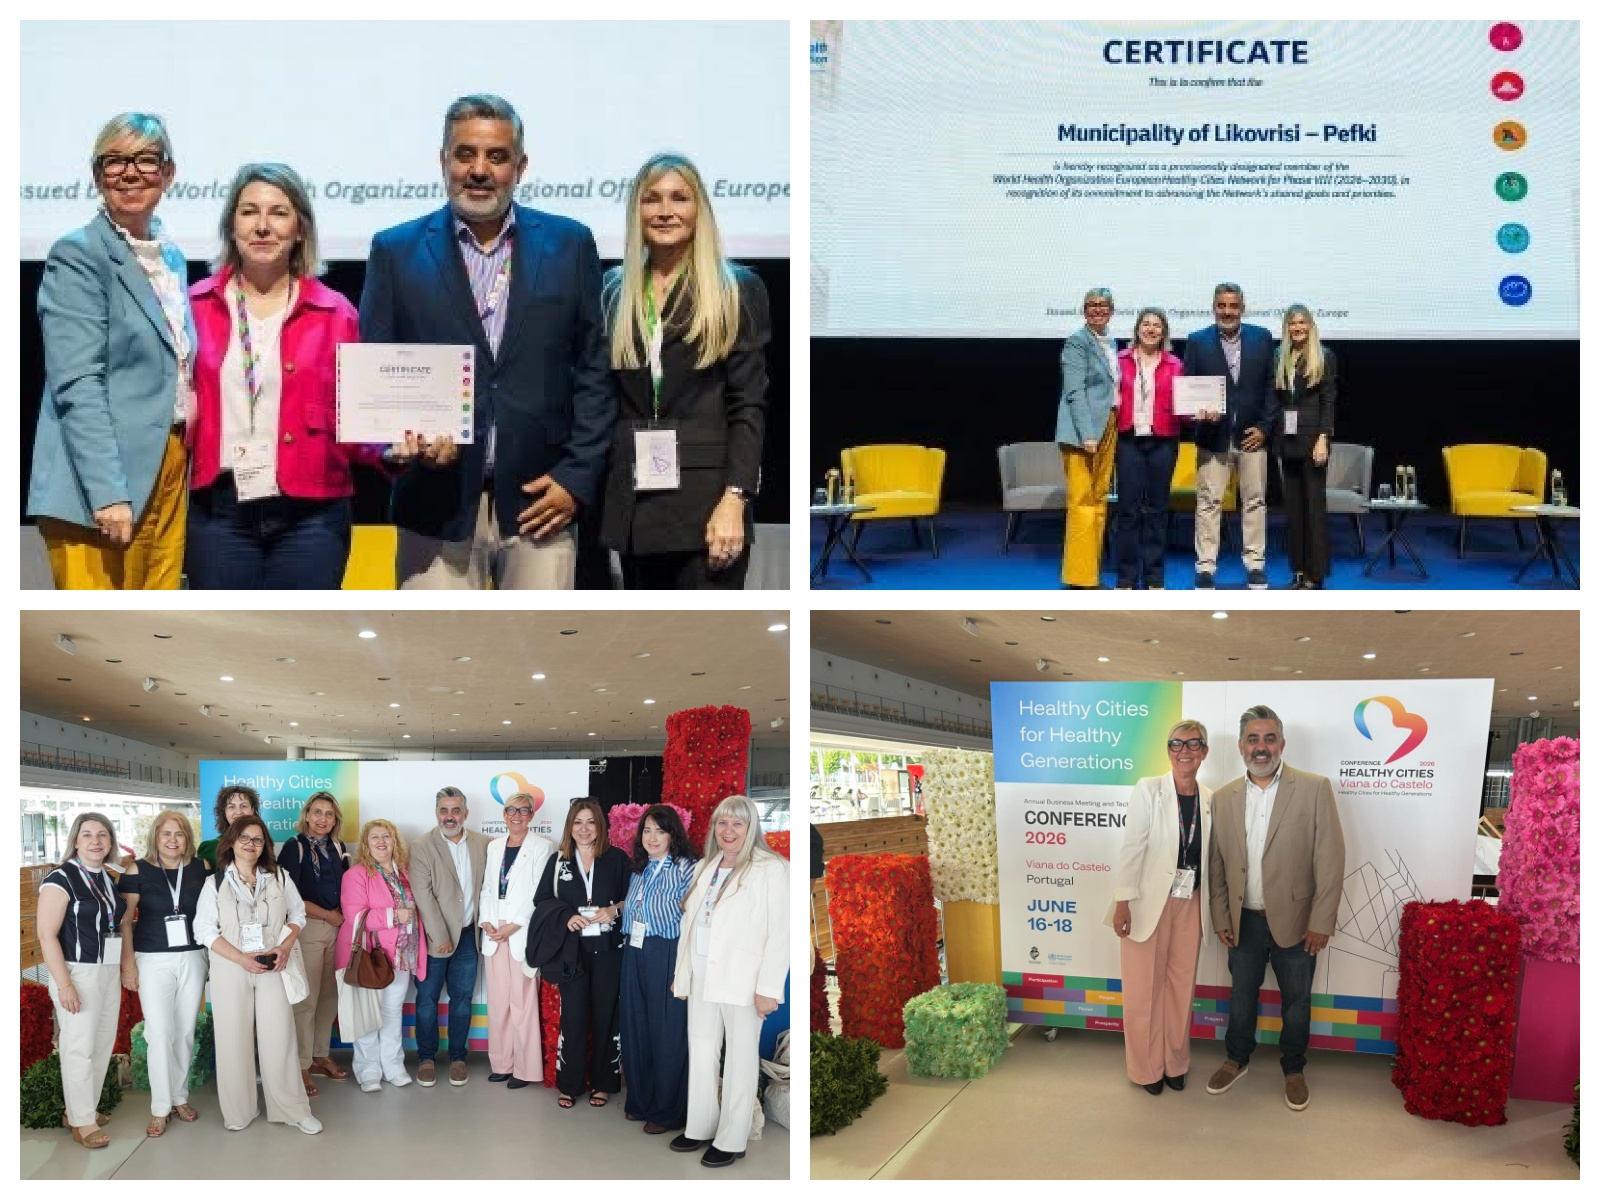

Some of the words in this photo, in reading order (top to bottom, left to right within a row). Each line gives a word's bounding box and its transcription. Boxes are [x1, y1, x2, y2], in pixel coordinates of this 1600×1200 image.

[1102, 39, 1309, 65] CERTIFICATE
[1057, 123, 1185, 146] Municipality
[1188, 122, 1212, 142] of
[1214, 123, 1301, 143] Likovrisi
[1323, 123, 1378, 143] Pefki
[324, 178, 444, 204] Organizati
[518, 178, 594, 204] gional
[1019, 699, 1091, 720] Healthy
[1095, 699, 1150, 717] Cities
[1019, 726, 1045, 743] for
[1050, 726, 1122, 747] Healthy
[1020, 752, 1134, 771] Generations
[1339, 769, 1394, 778] HEALTHY
[1396, 769, 1435, 778] CITIES
[224, 774, 285, 792] Healthy
[288, 774, 333, 789] Cities
[1339, 779, 1371, 788] Viana
[1372, 779, 1387, 788] do
[1390, 779, 1433, 789] Castelo
[261, 796, 304, 810] ealth
[1075, 800, 1101, 809] Meeting
[1024, 810, 1127, 828] CONFEREN
[481, 826, 508, 834] HEALT
[528, 826, 552, 834] ITIES
[1025, 831, 1067, 845] 2026
[1025, 859, 1054, 870] Viana
[1056, 860, 1070, 871] do
[1072, 861, 1111, 872] Castelo
[1026, 874, 1074, 888] Portugal
[1027, 899, 1077, 914] JUNE
[1027, 917, 1073, 933] 16-18
[1028, 976, 1059, 984] Participation
